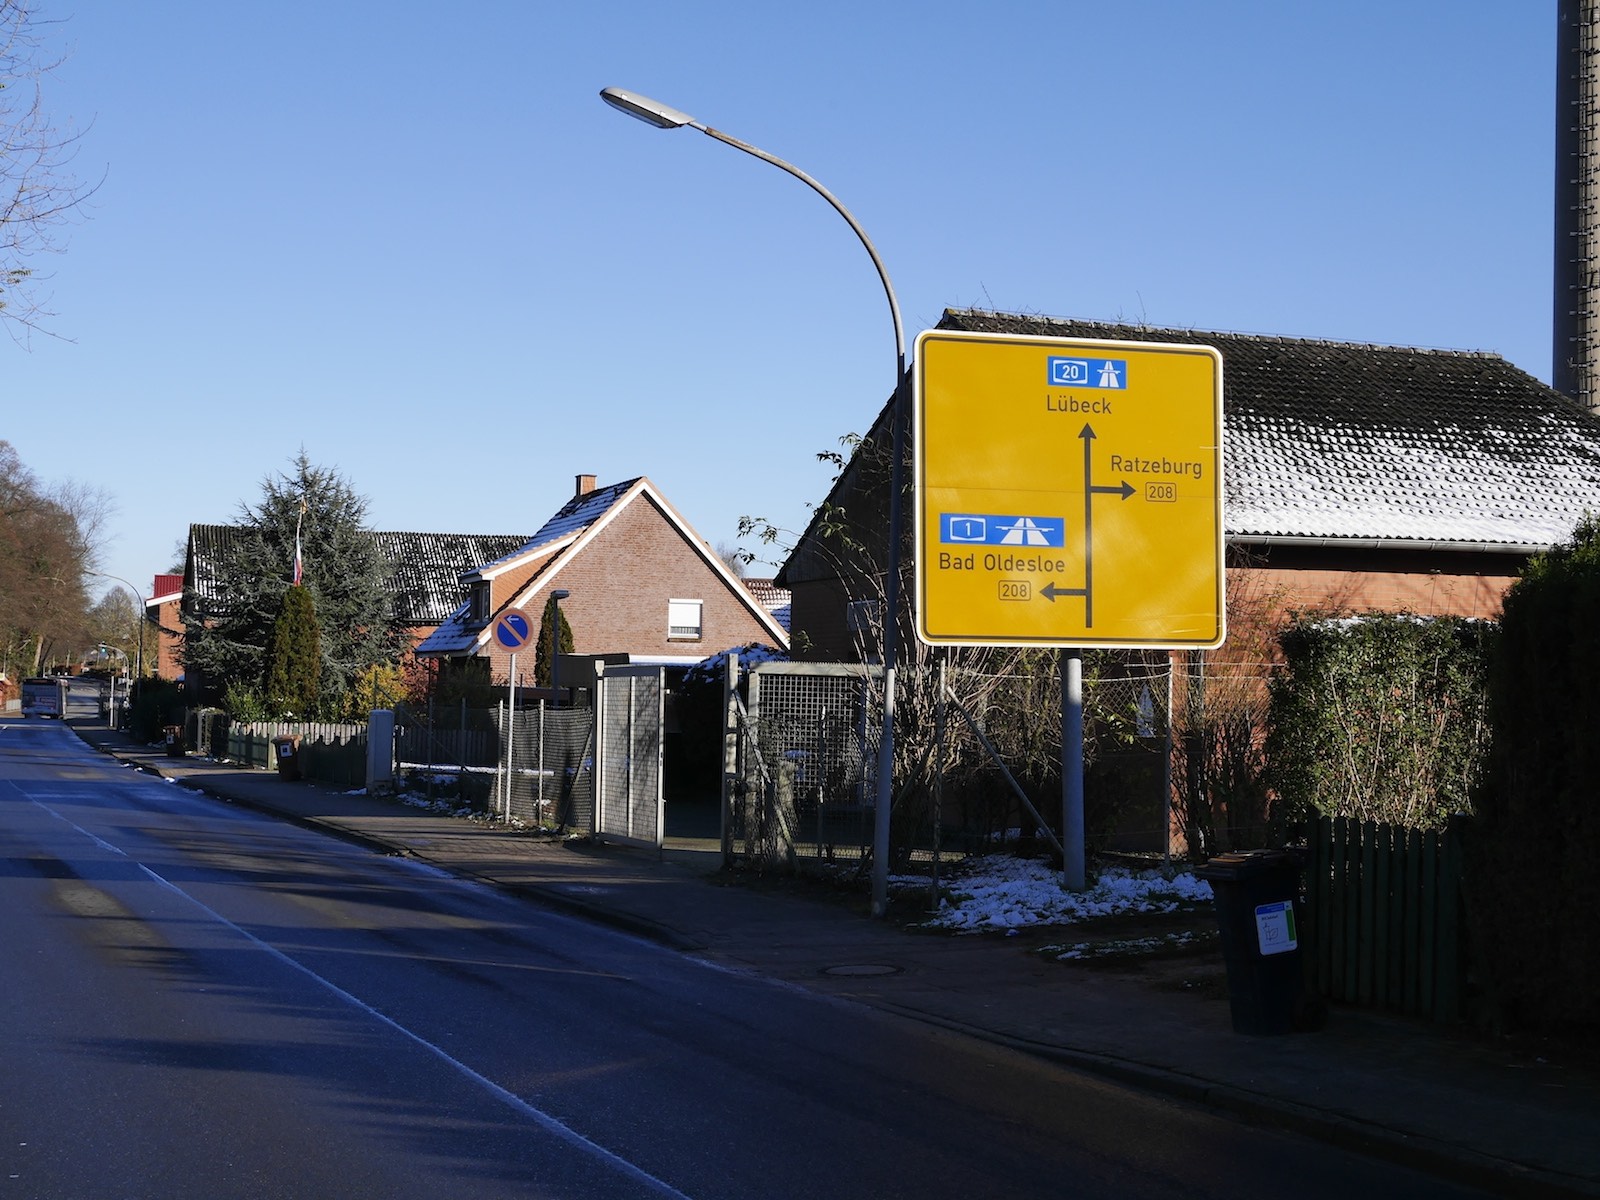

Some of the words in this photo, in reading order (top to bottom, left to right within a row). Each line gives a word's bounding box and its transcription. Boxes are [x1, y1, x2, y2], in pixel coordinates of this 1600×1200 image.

[1062, 364, 1079, 379] 20
[1047, 395, 1112, 414] Lübeck
[1111, 455, 1202, 479] Ratzeburg
[1149, 485, 1173, 499] 208
[964, 523, 971, 536] 1
[939, 553, 974, 570] Bad
[984, 555, 1065, 573] Oldesloe
[1002, 583, 1027, 598] 208
